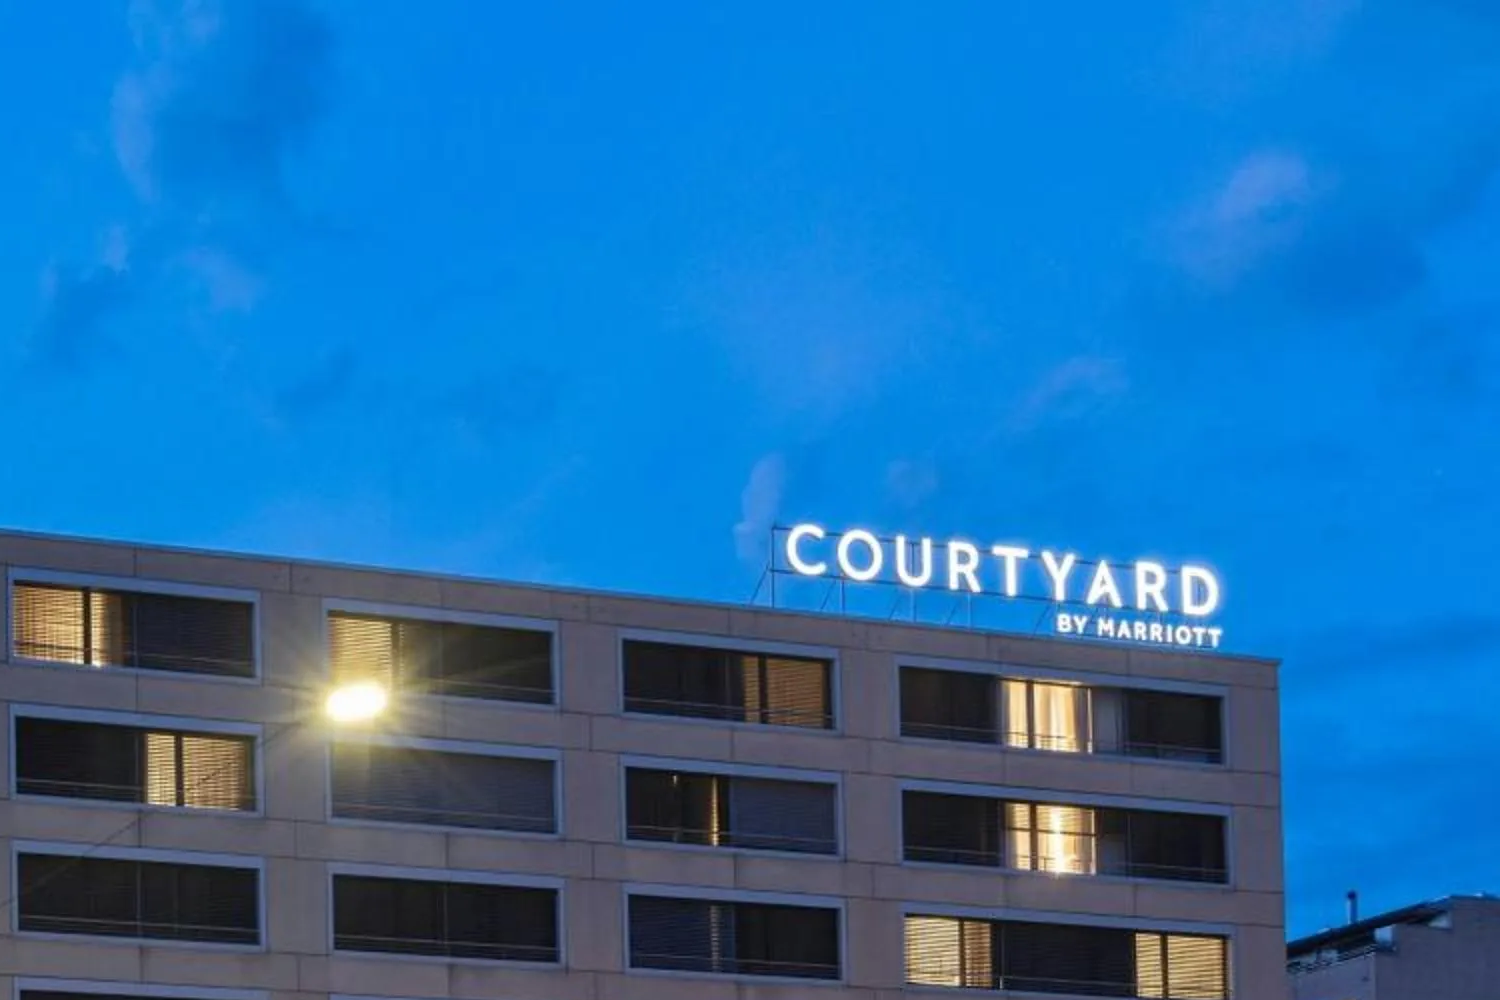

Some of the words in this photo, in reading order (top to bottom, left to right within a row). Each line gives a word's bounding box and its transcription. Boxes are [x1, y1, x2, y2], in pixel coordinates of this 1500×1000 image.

[785, 524, 1220, 617] COURTYARD
[1056, 613, 1087, 634] BY
[1097, 617, 1222, 647] MARRIOTT
